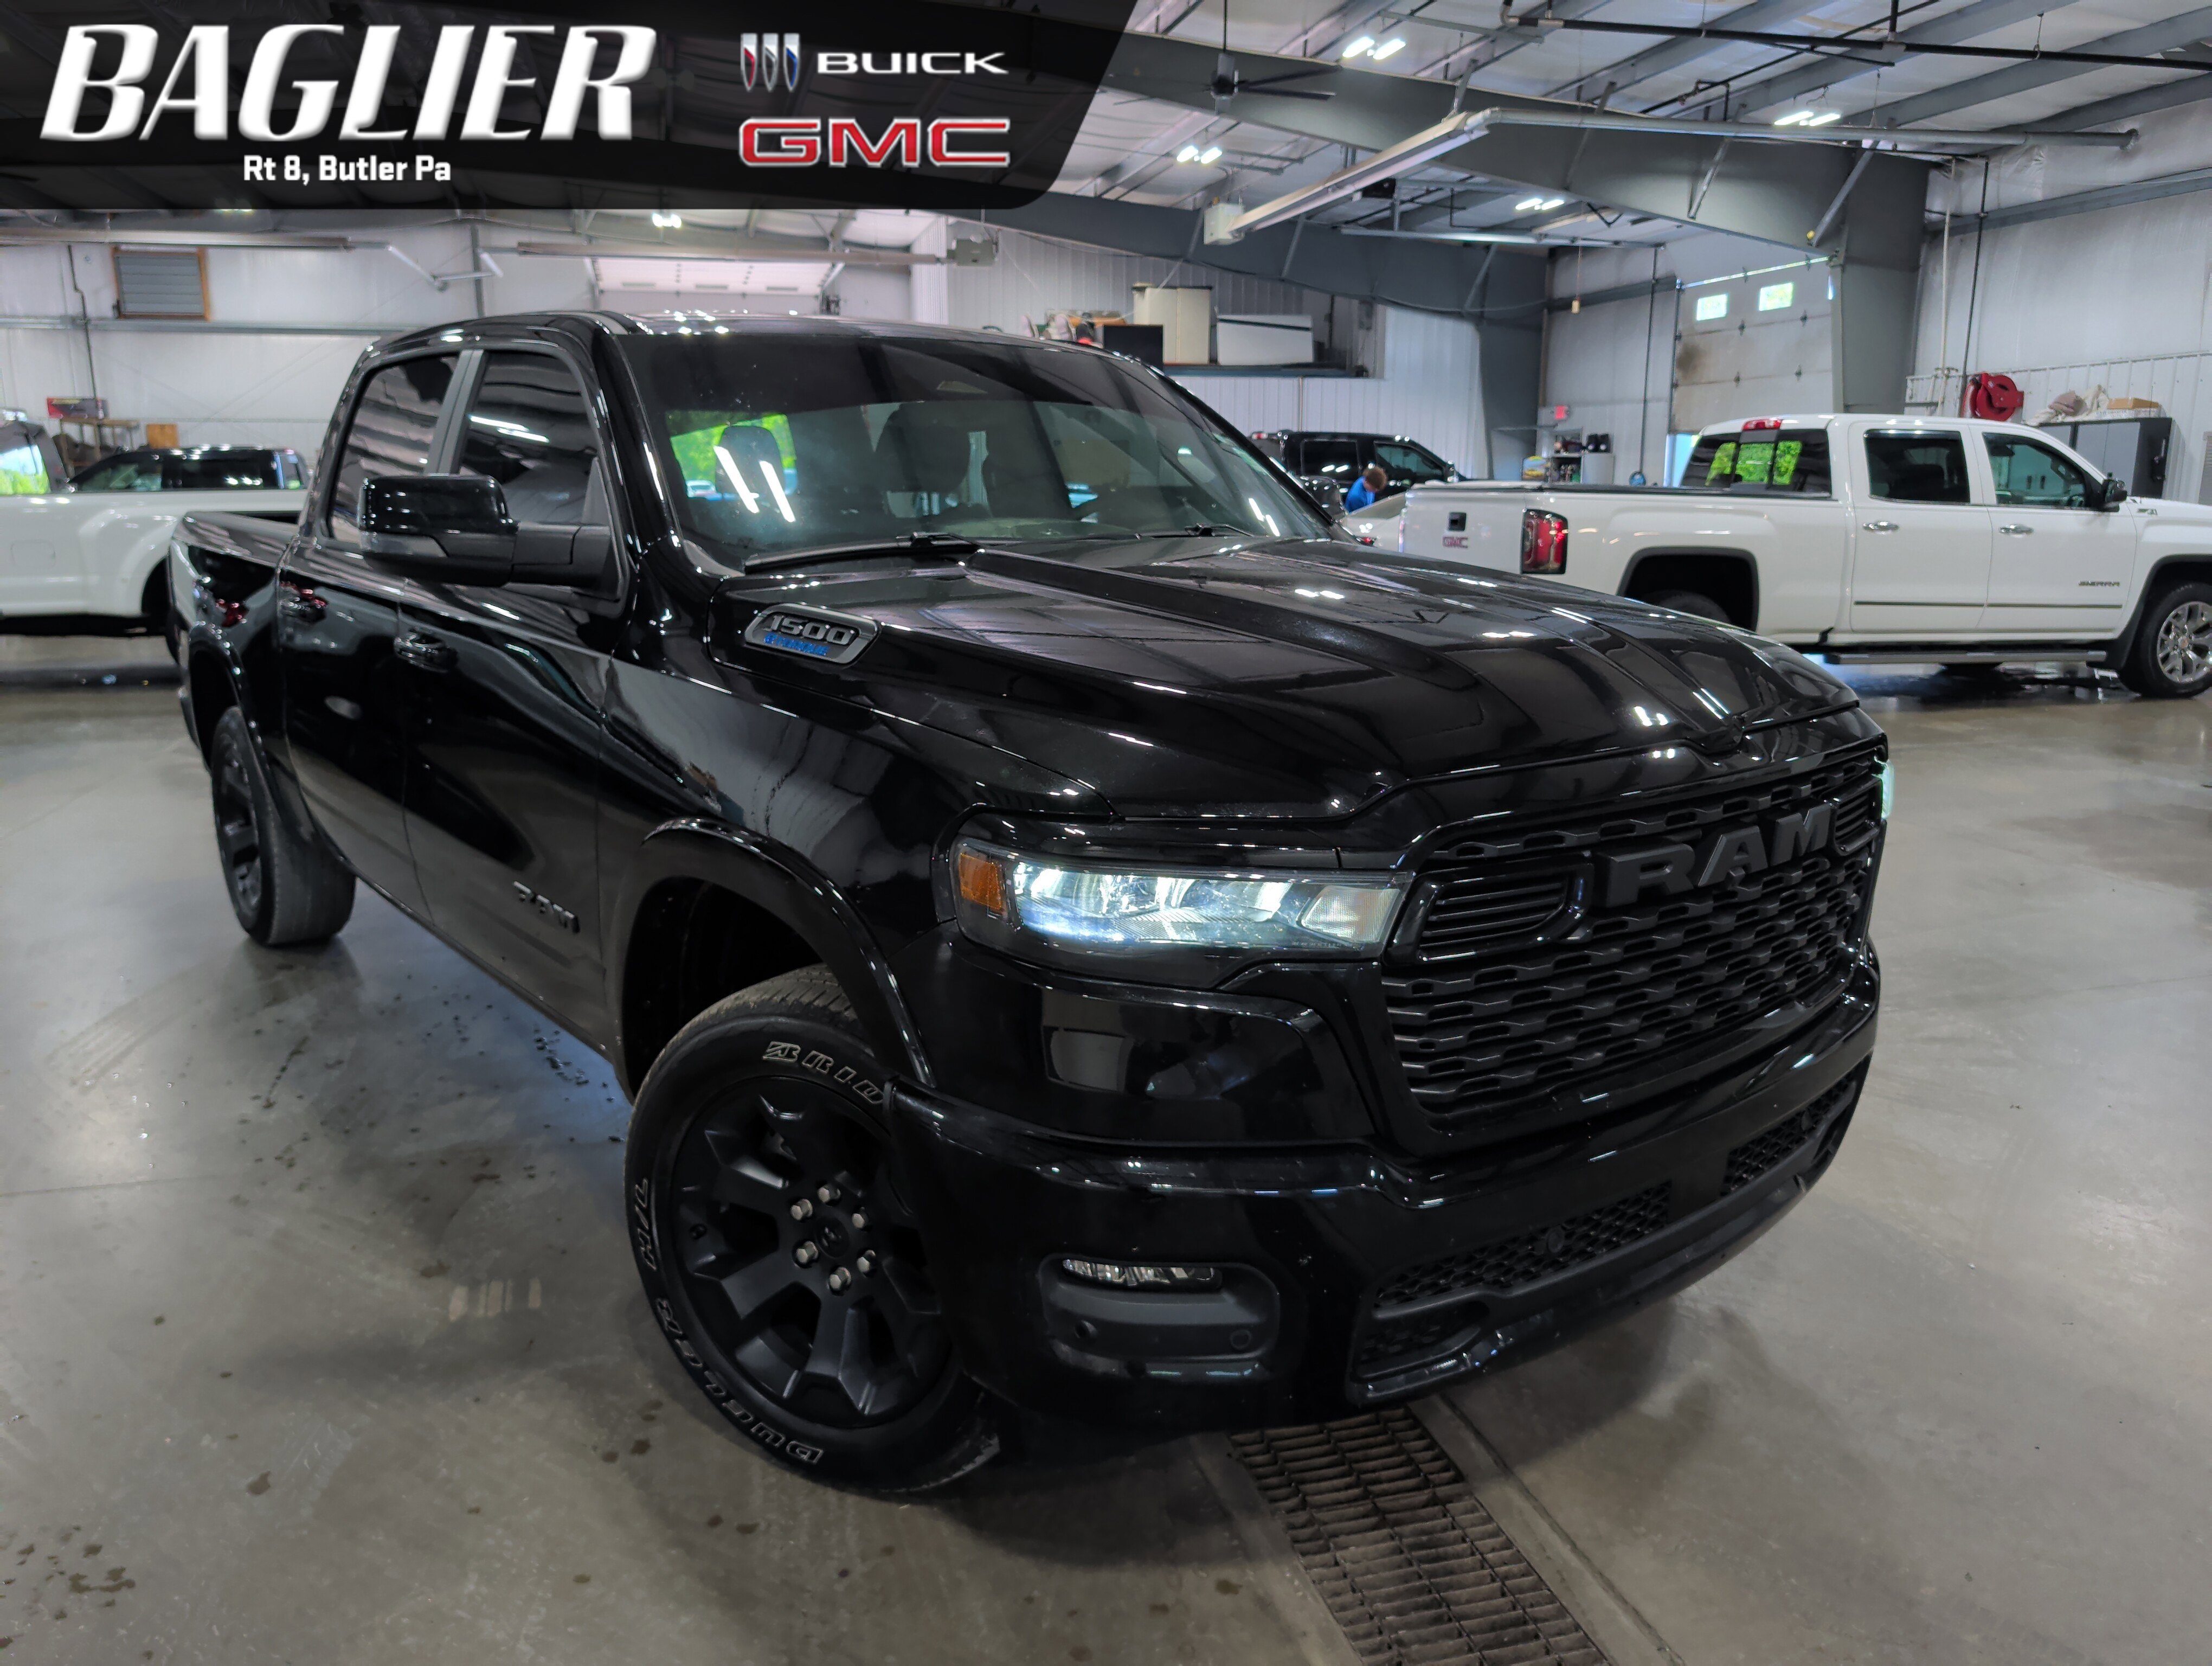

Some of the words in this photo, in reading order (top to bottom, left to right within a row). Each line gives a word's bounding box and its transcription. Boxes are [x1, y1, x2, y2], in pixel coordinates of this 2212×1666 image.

[1442, 536, 1468, 548] GMC
[763, 614, 851, 645] 1500
[1606, 802, 1832, 907] RAM
[655, 1298, 825, 1464] DUELER
